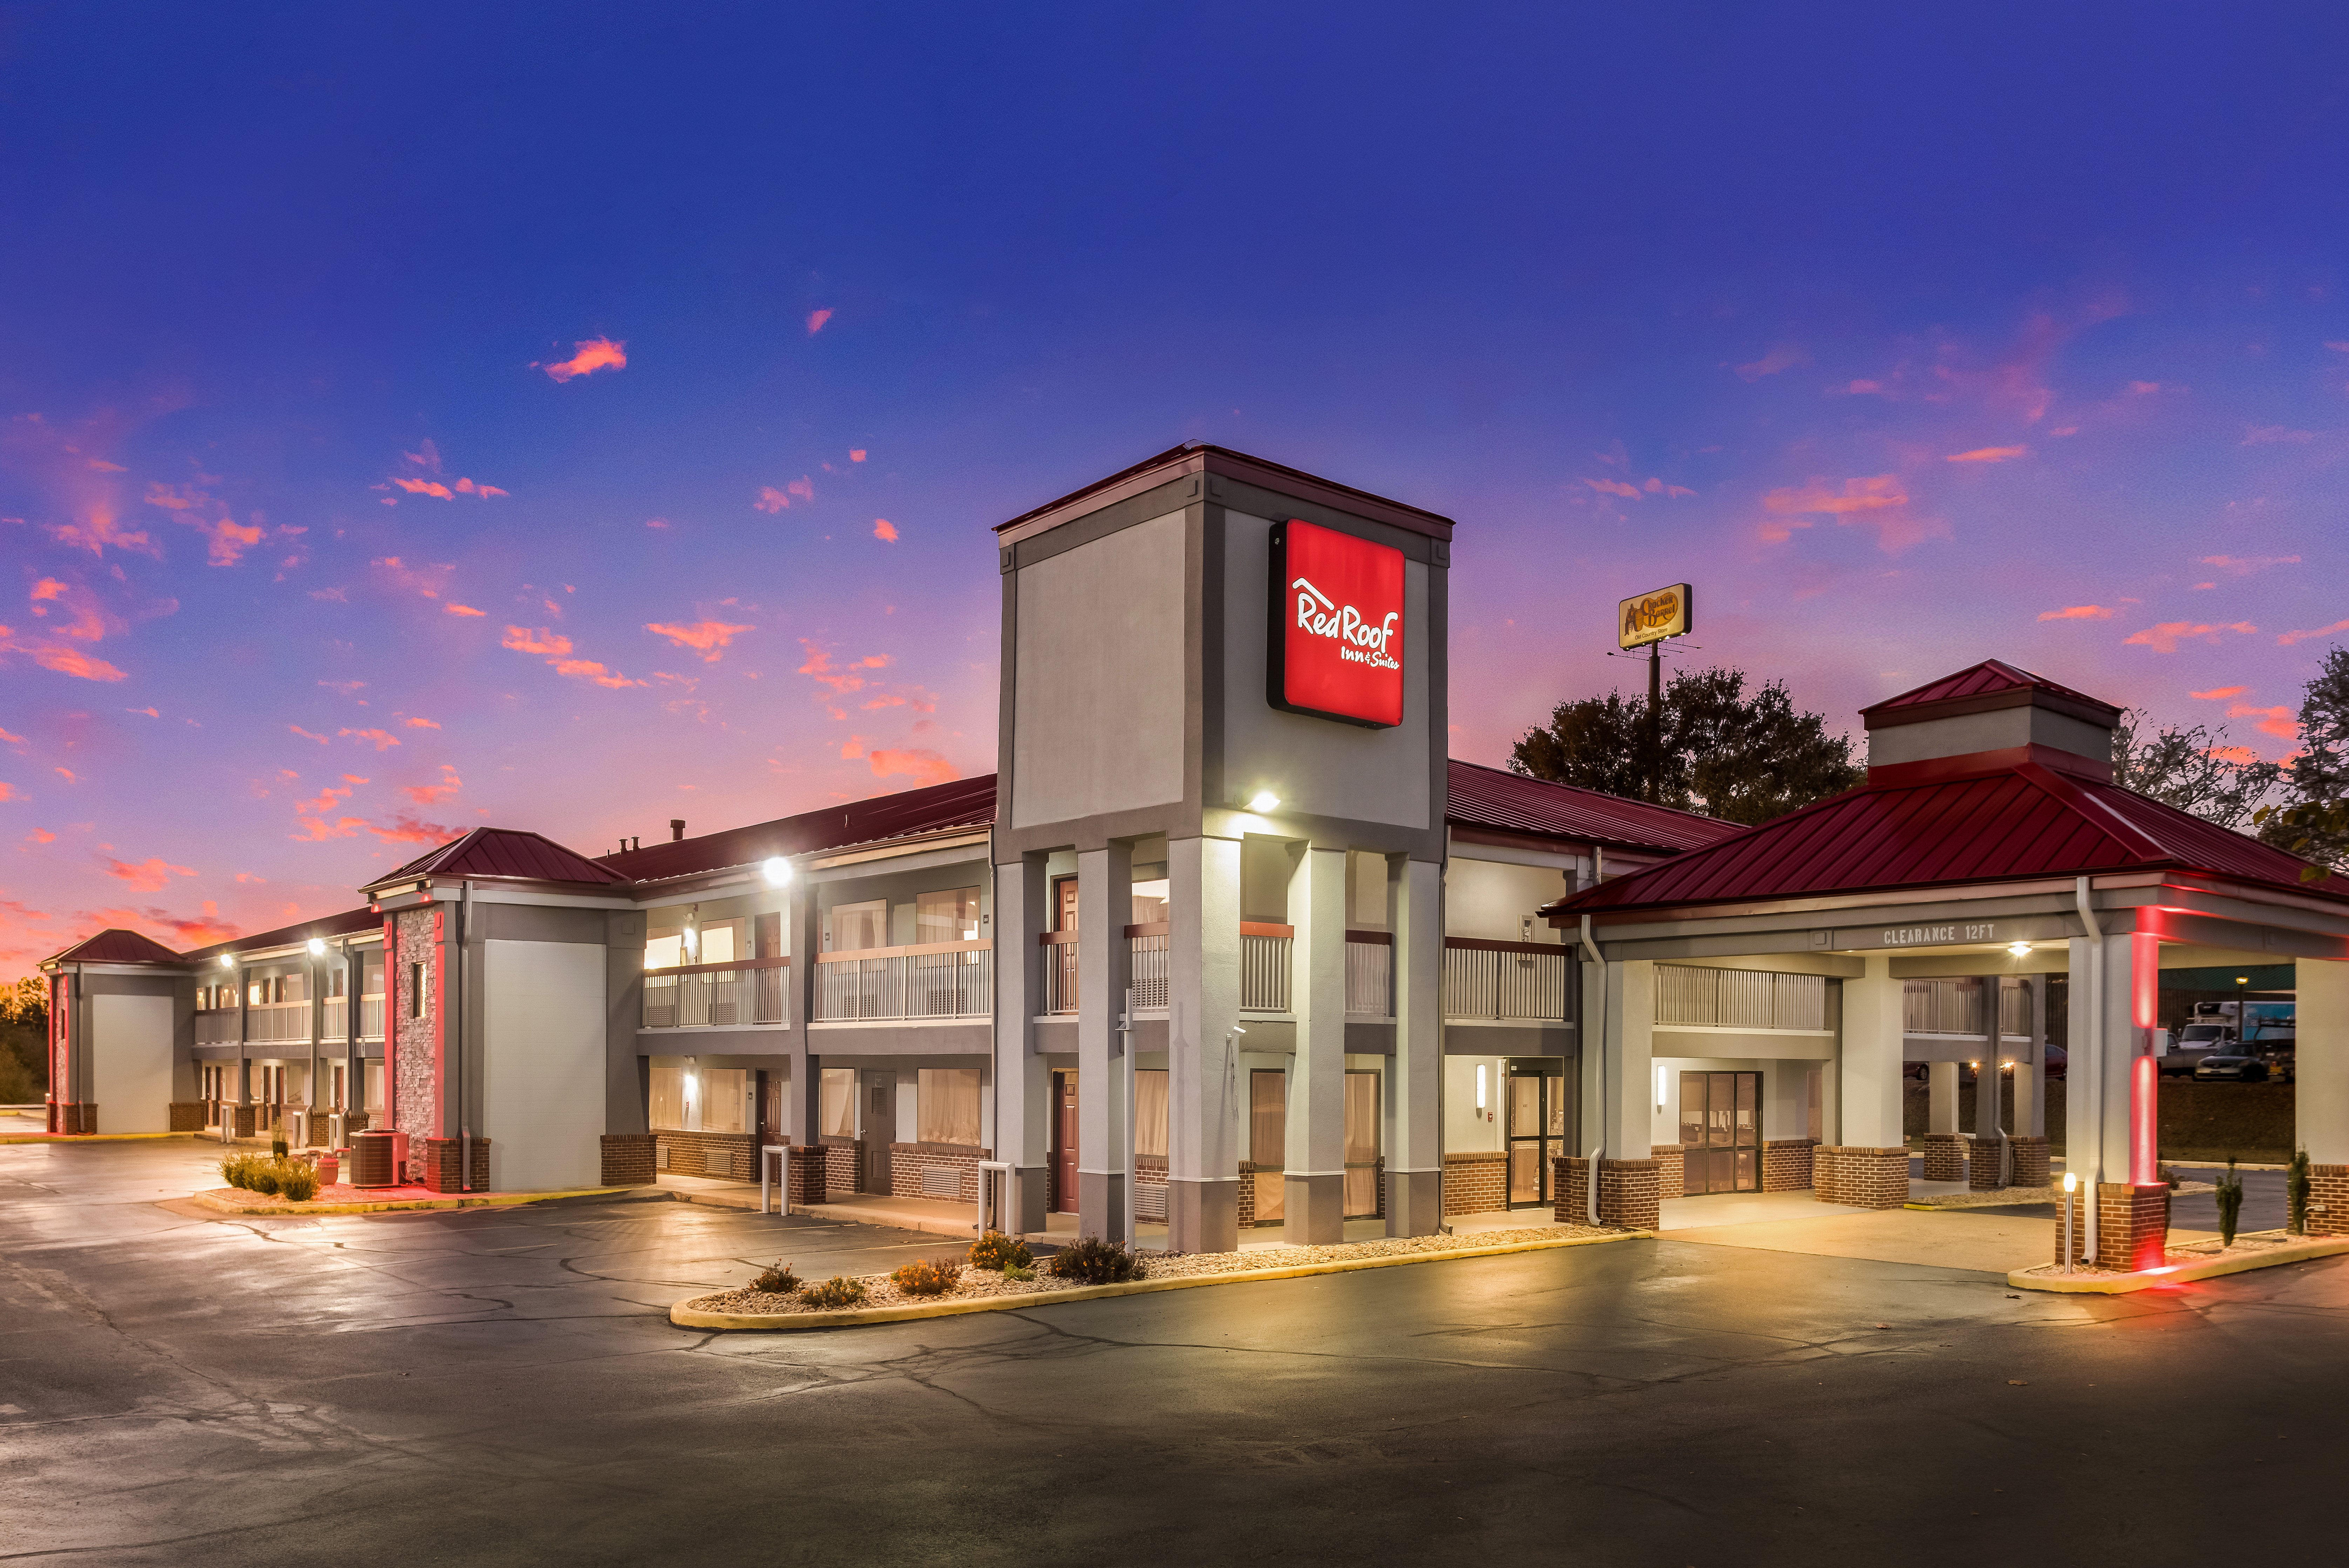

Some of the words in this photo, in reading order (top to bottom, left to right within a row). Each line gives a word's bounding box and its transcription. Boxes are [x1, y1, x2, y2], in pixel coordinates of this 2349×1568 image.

[1298, 593, 1341, 638] Red
[1343, 605, 1398, 654] Roof
[1341, 646, 1364, 663] Inn
[1364, 651, 1371, 664] &
[1370, 651, 1400, 670] Suites
[1884, 926, 1955, 944] CLEARANCE
[1965, 924, 1994, 939] 12FT
